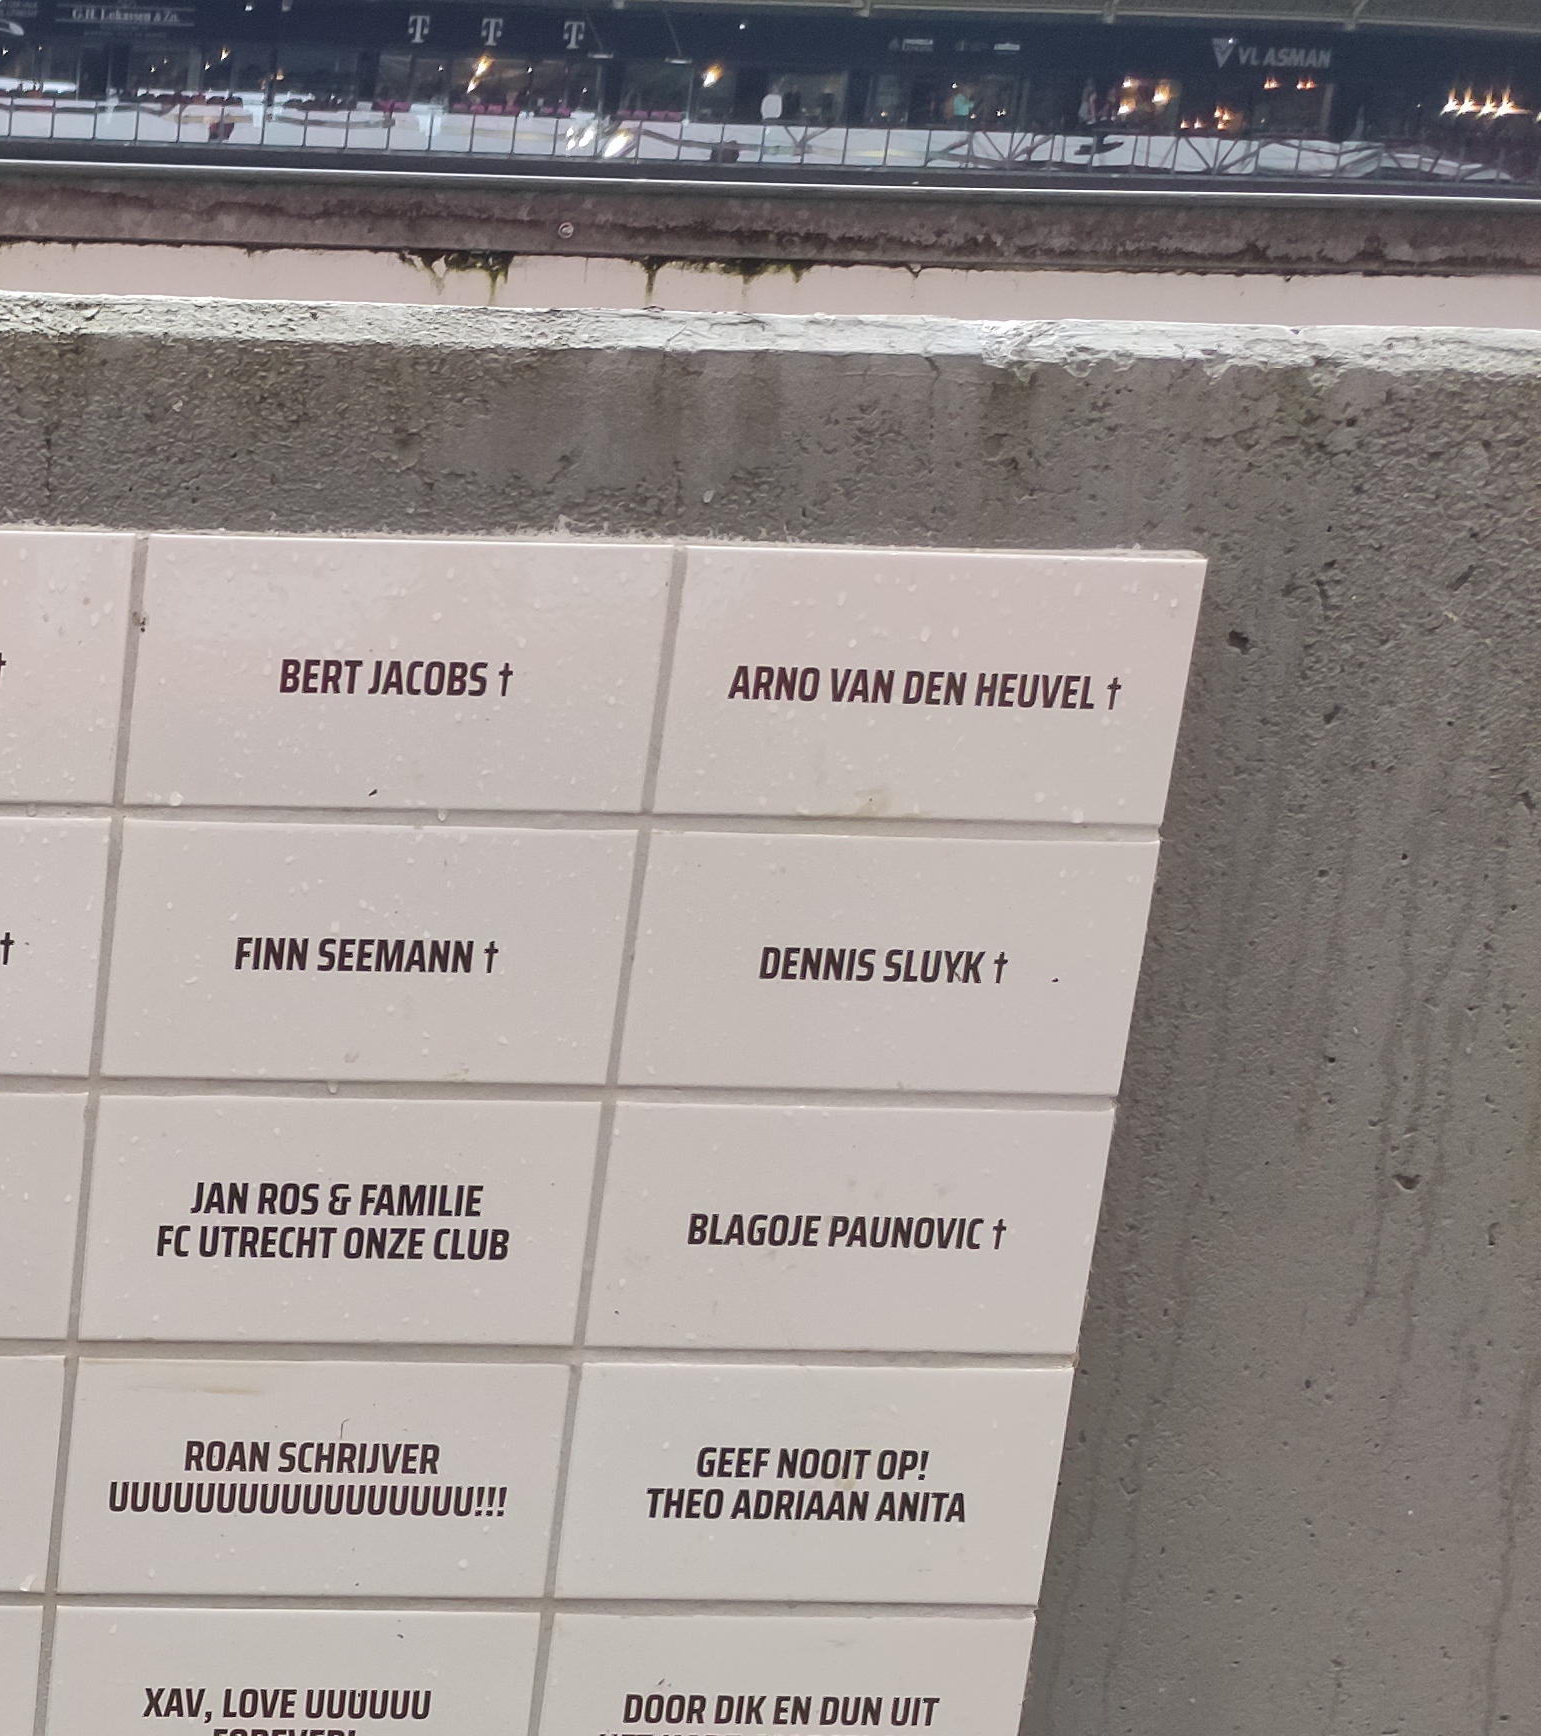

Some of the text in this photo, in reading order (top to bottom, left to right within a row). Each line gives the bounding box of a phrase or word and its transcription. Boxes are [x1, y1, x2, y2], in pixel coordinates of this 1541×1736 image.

[279, 658, 489, 697] BERT JACOBS
[727, 665, 1095, 710] ARNO VAN DEN HEUVEL
[234, 936, 475, 974] FINN SEEMANN
[759, 946, 986, 984] DENNIS SLUYK
[189, 1181, 484, 1217] JAN ROS & FAMILIE
[156, 1225, 510, 1261] FC UTRECHT ONZE CLUB
[687, 1213, 985, 1250] BLAGOJE PAUNOVIC
[184, 1440, 440, 1475] ROAN SCHRIJVER
[696, 1446, 930, 1481] GEEF NOOIT OP!
[646, 1487, 965, 1523] THEO ADRIAAN ANITA
[141, 1687, 213, 1724] XAV,
[222, 1688, 298, 1719] LOVE
[622, 1693, 941, 1727] DOOR DIK EN DUN UIT
